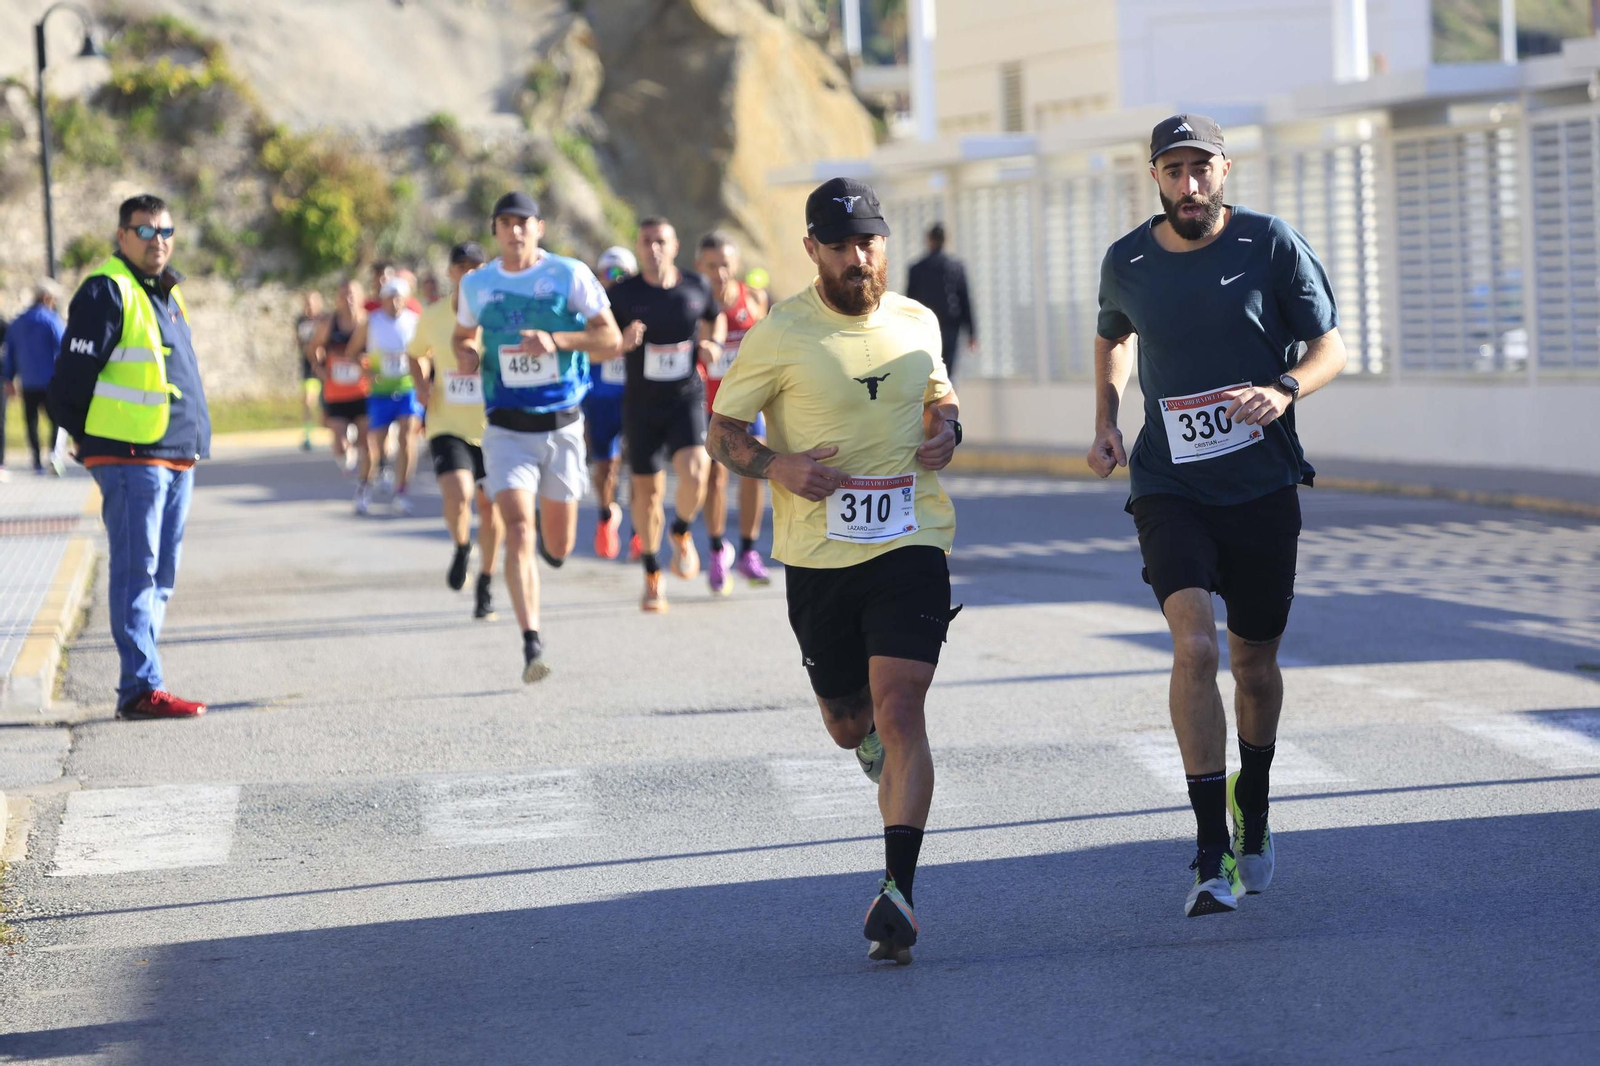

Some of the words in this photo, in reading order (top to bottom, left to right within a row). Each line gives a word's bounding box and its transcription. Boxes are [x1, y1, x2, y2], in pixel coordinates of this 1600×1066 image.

[508, 357, 540, 373] 485
[1178, 406, 1232, 442] 330
[1194, 439, 1218, 449] CRISTIAN
[840, 493, 891, 524] 310
